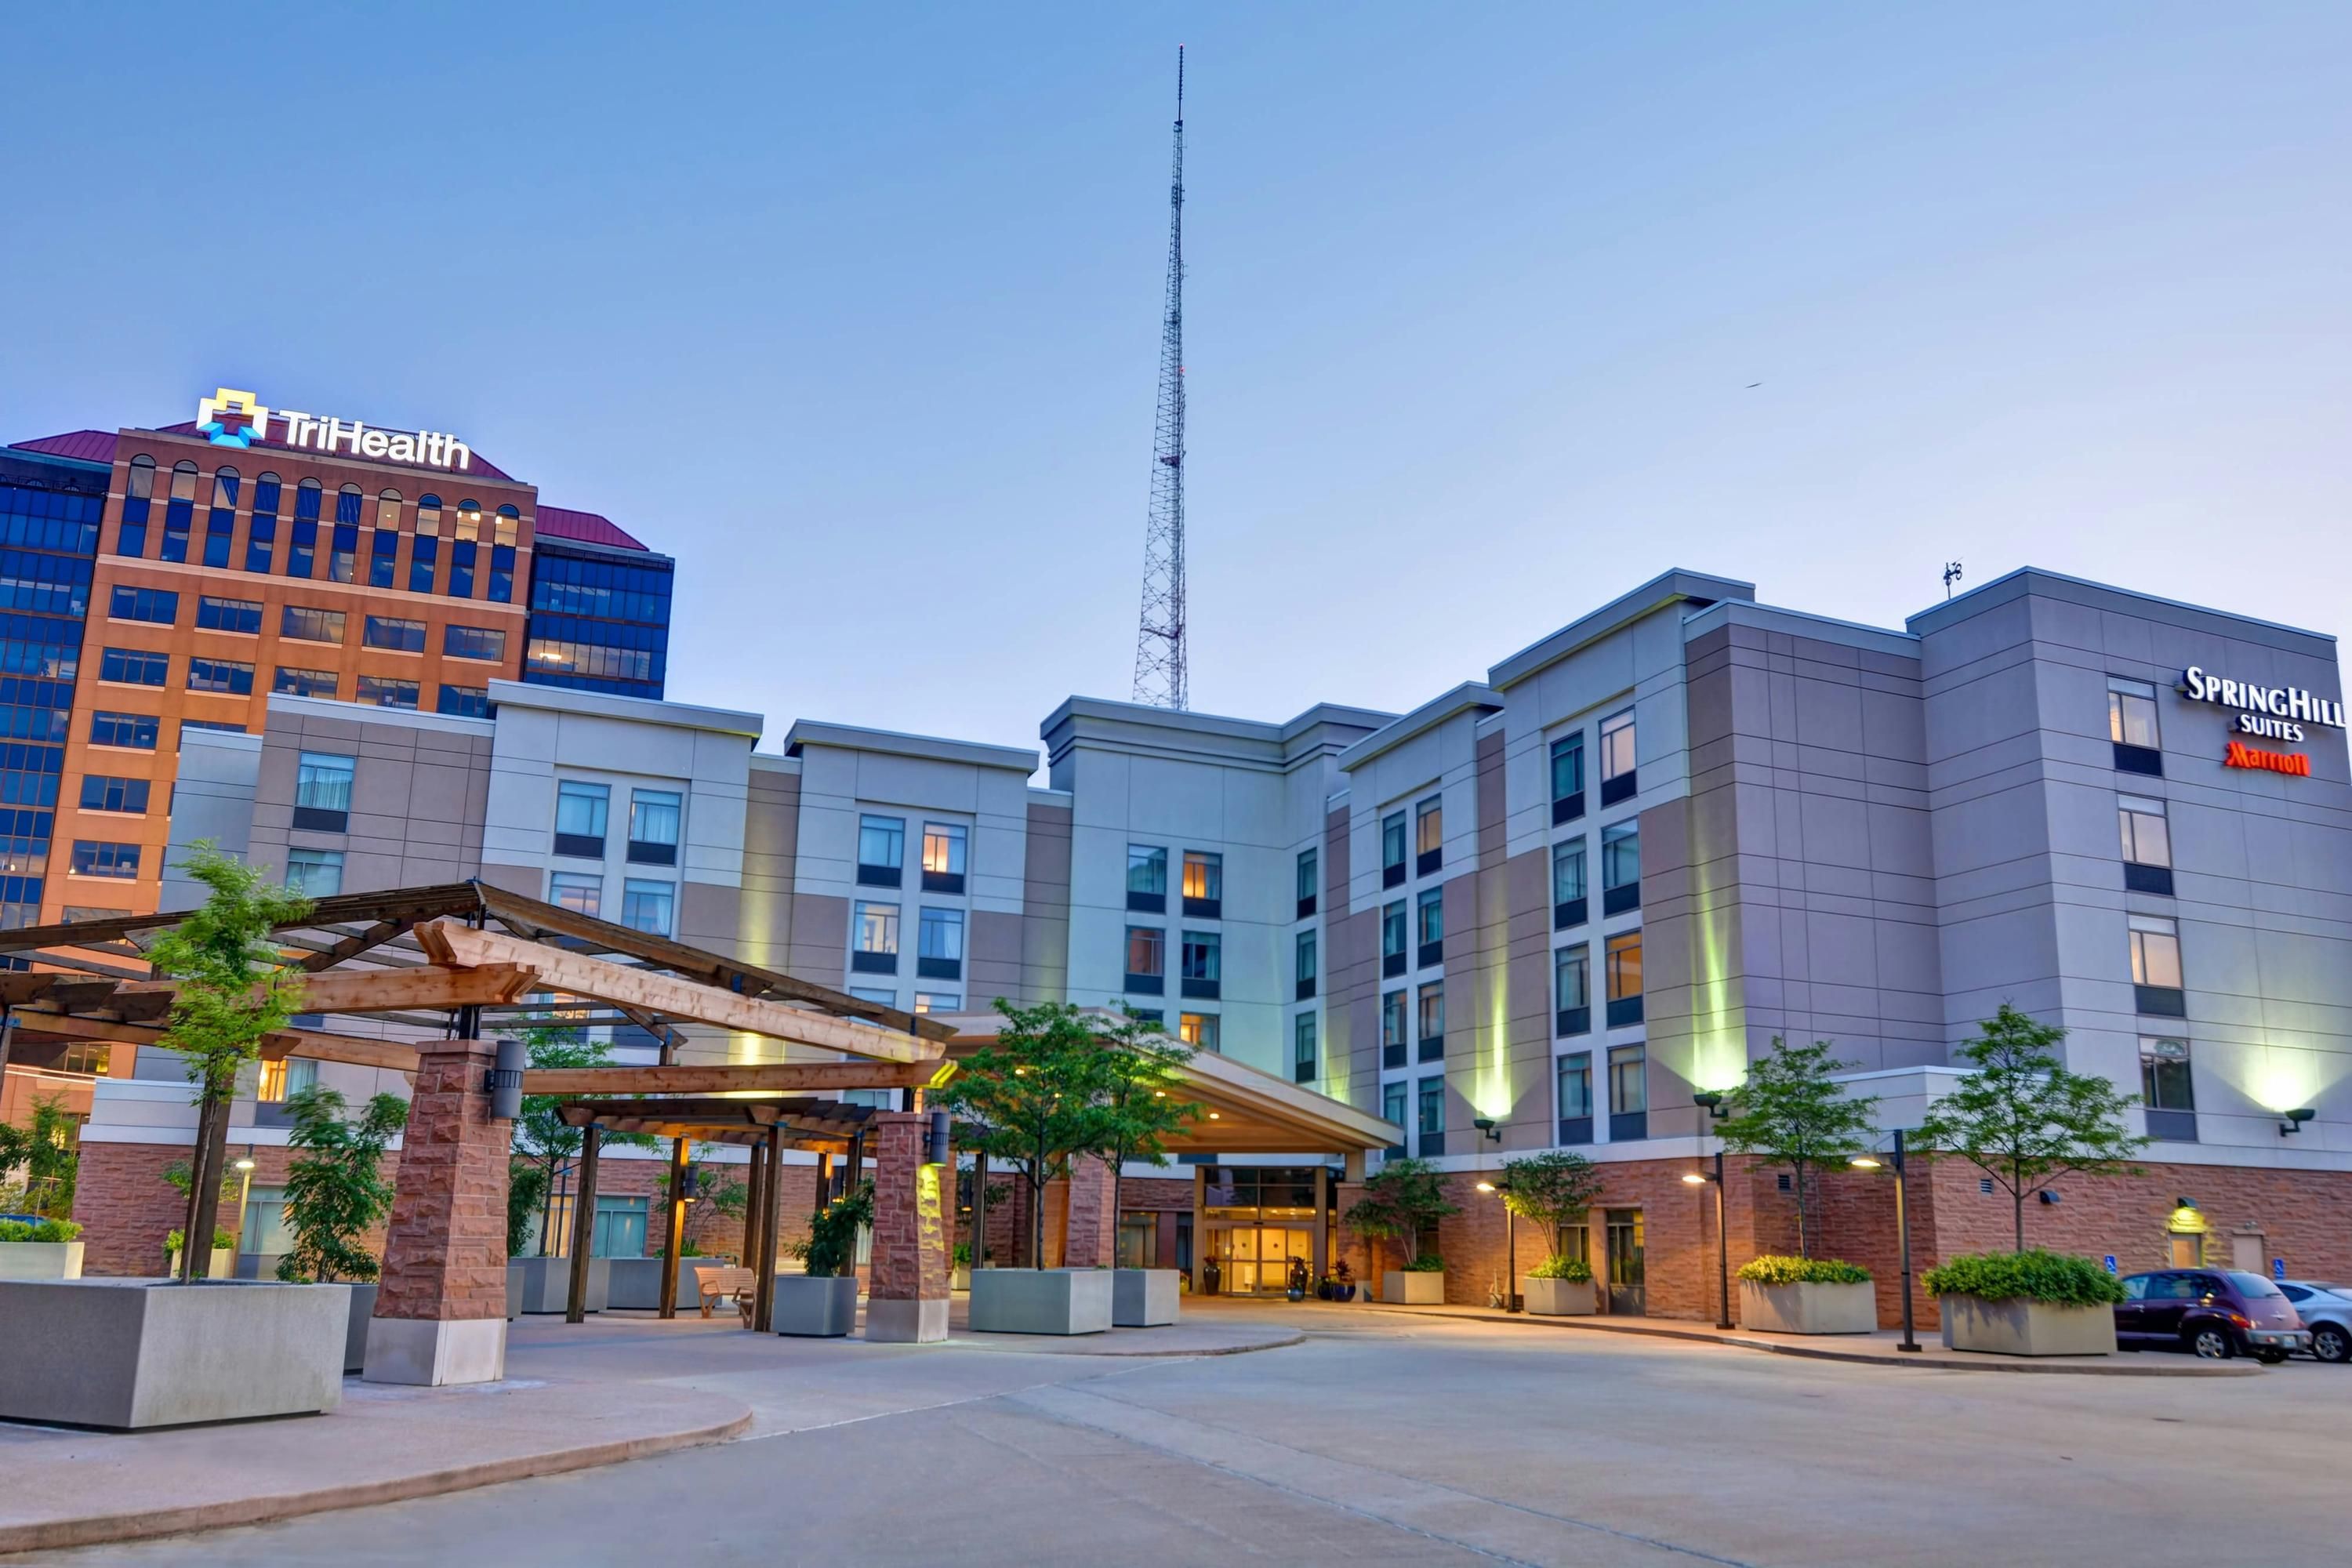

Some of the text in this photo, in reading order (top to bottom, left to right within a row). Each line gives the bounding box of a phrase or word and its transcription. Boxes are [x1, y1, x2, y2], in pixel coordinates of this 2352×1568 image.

[279, 409, 470, 470] TriHealth
[2184, 666, 2347, 728] SPRINGHILL
[2238, 713, 2304, 742] SUITES
[2225, 740, 2310, 777] Marriott
